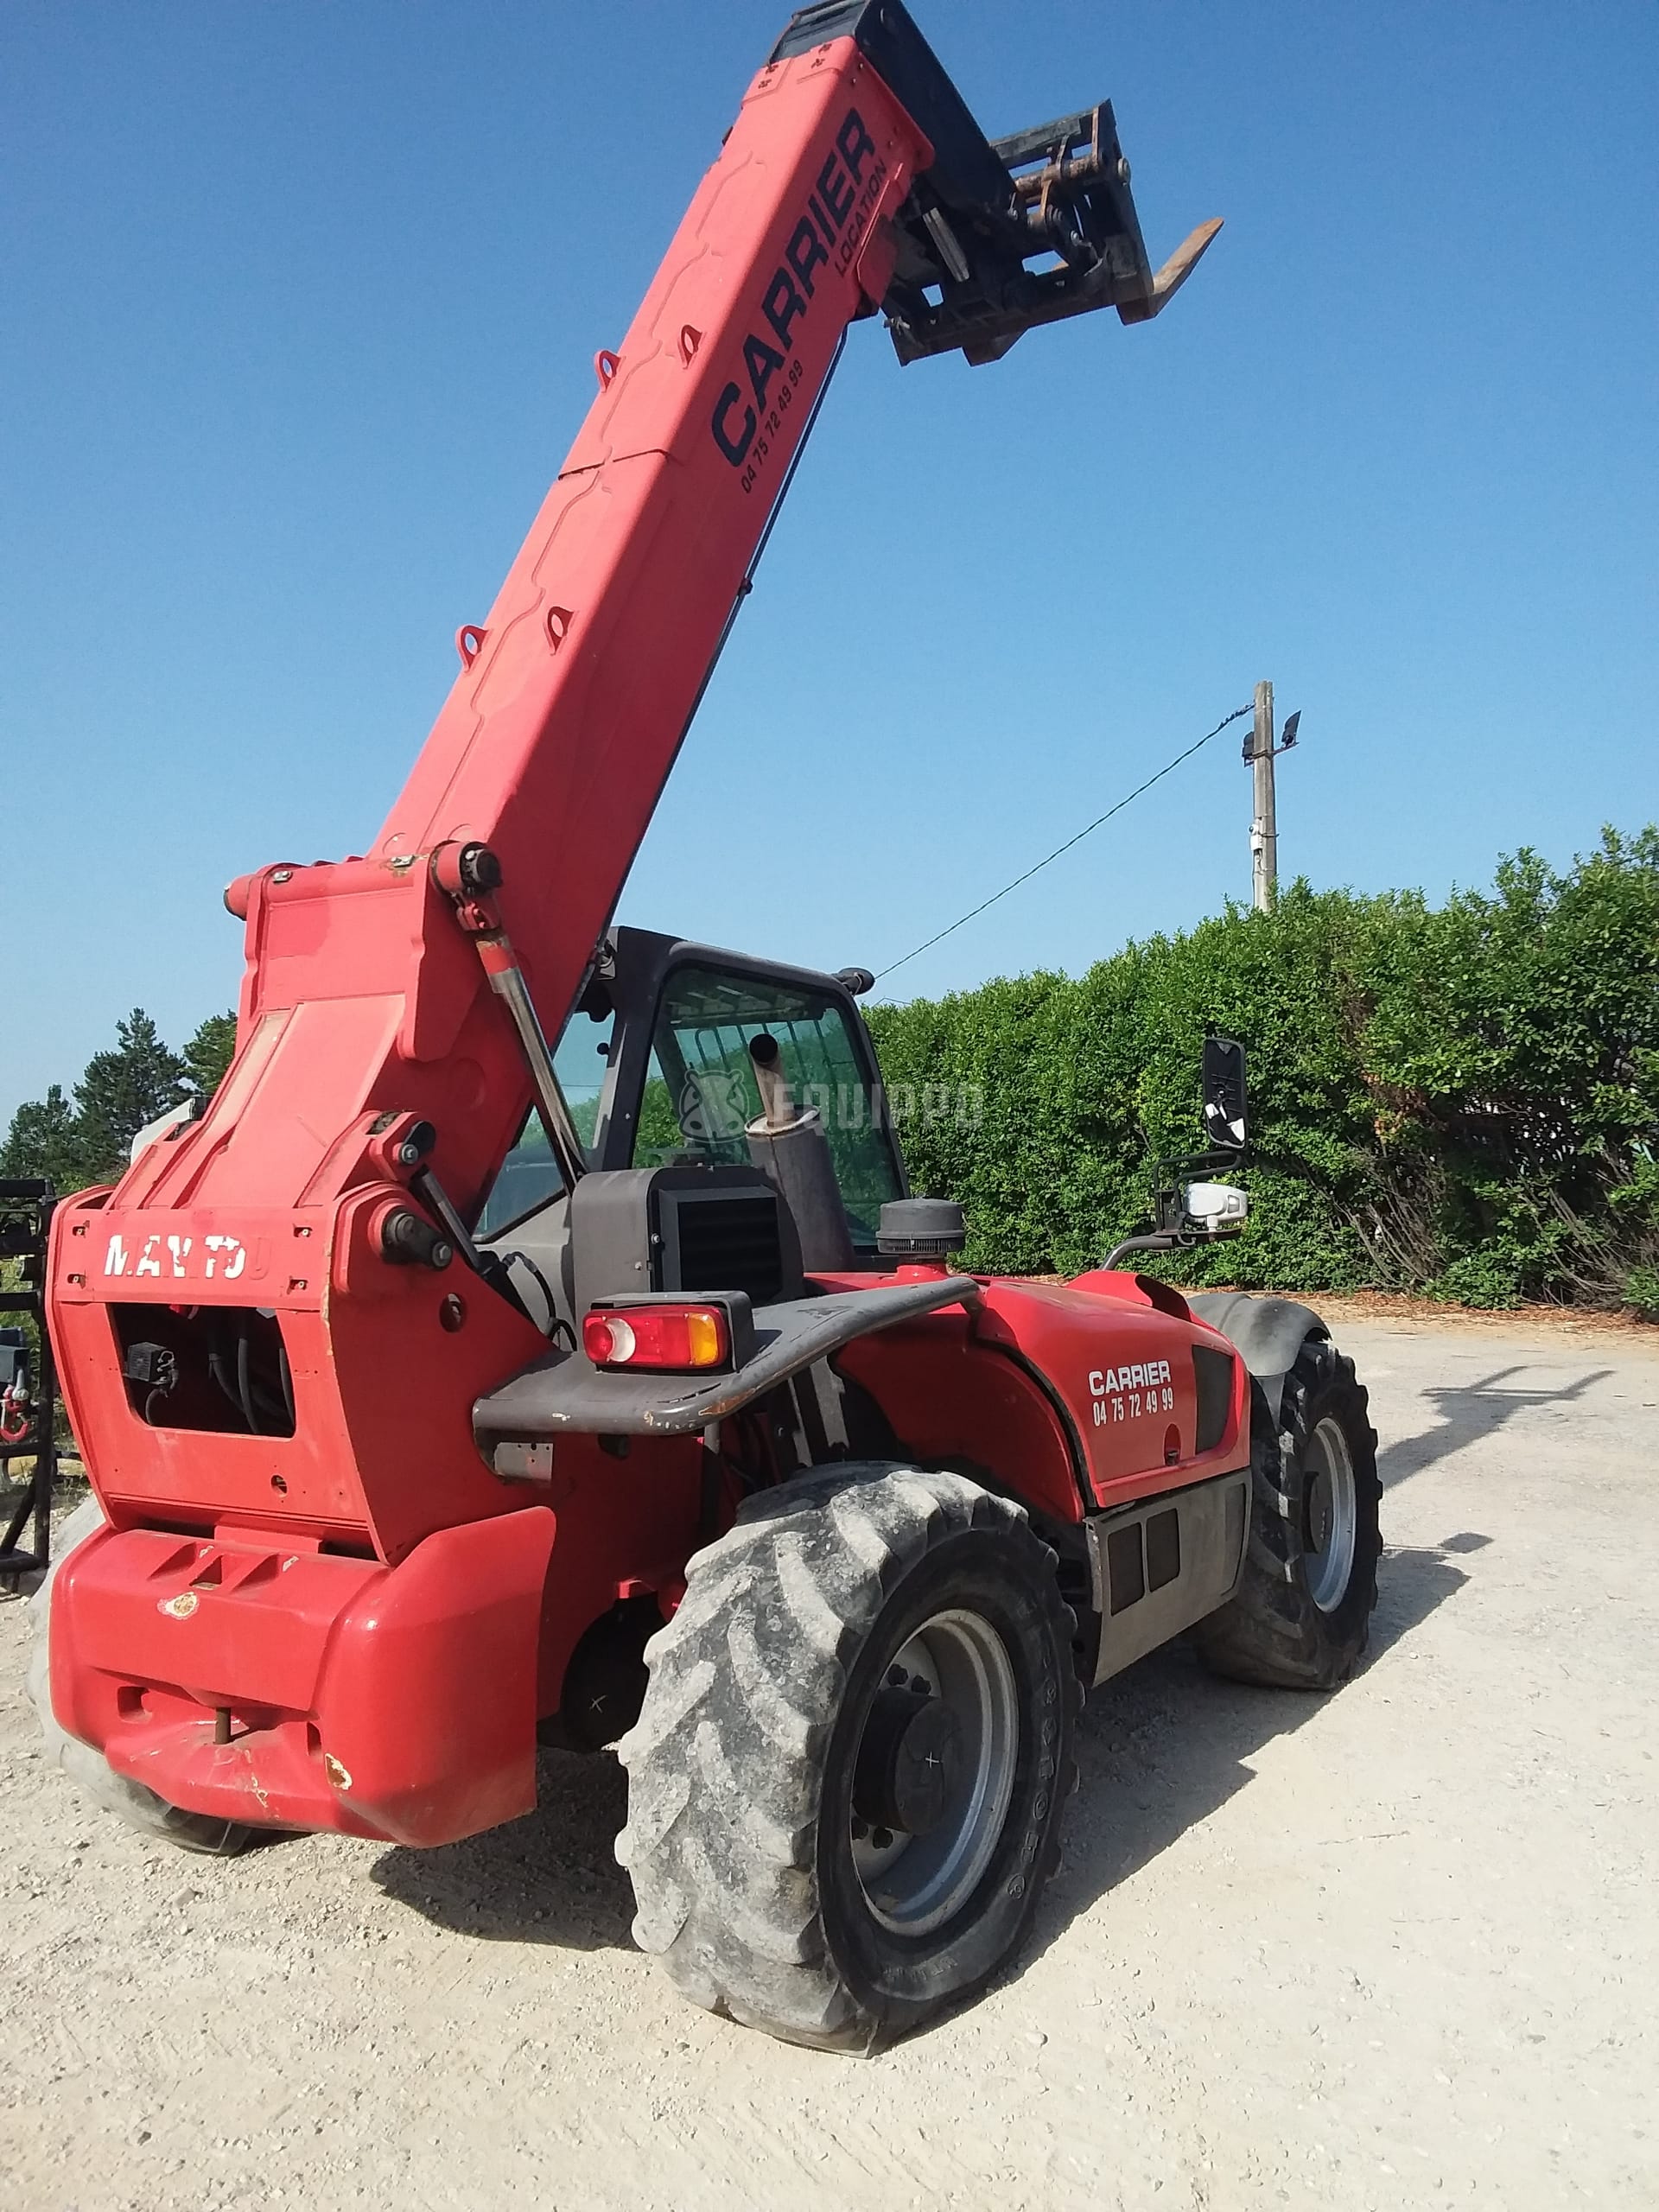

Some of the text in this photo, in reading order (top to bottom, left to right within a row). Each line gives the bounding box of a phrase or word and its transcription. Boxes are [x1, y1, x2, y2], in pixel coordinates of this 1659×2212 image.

[836, 158, 887, 277] LOCATION
[711, 107, 875, 467] CARRIER
[741, 359, 804, 493] 04 75 72 49 99
[1088, 1360, 1171, 1396] CARRIER
[1093, 1387, 1173, 1427] 04 75 72 49 99
